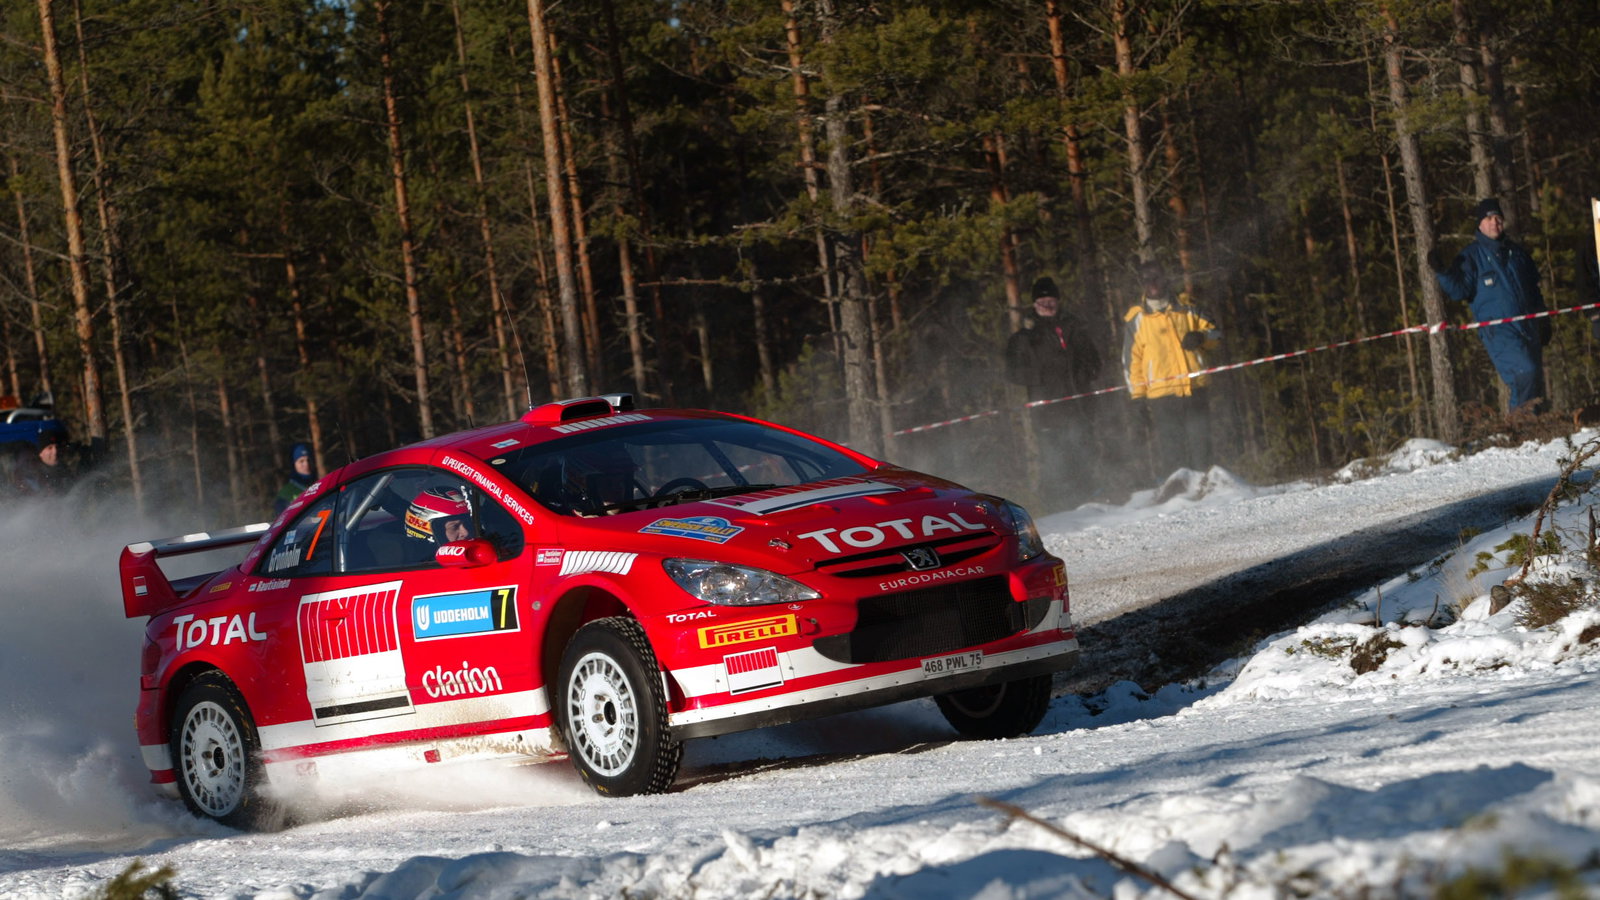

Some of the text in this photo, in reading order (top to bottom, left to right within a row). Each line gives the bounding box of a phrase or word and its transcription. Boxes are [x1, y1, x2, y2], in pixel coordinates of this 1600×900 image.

[447, 457, 475, 477] PEUGEOT
[472, 471, 503, 499] FINANCIAL
[502, 494, 535, 525] SERVICES
[306, 509, 332, 561] 7
[702, 525, 737, 535] RALLY
[797, 512, 987, 554] TOTAL
[879, 565, 986, 592] EURODATACAR
[433, 606, 489, 625] UDDEHOLM
[497, 589, 510, 629] 7
[666, 610, 717, 624] TOTAL
[172, 612, 267, 651] TOTAL
[705, 616, 789, 645] PIRELLI
[924, 652, 982, 673] 468 PWL 75
